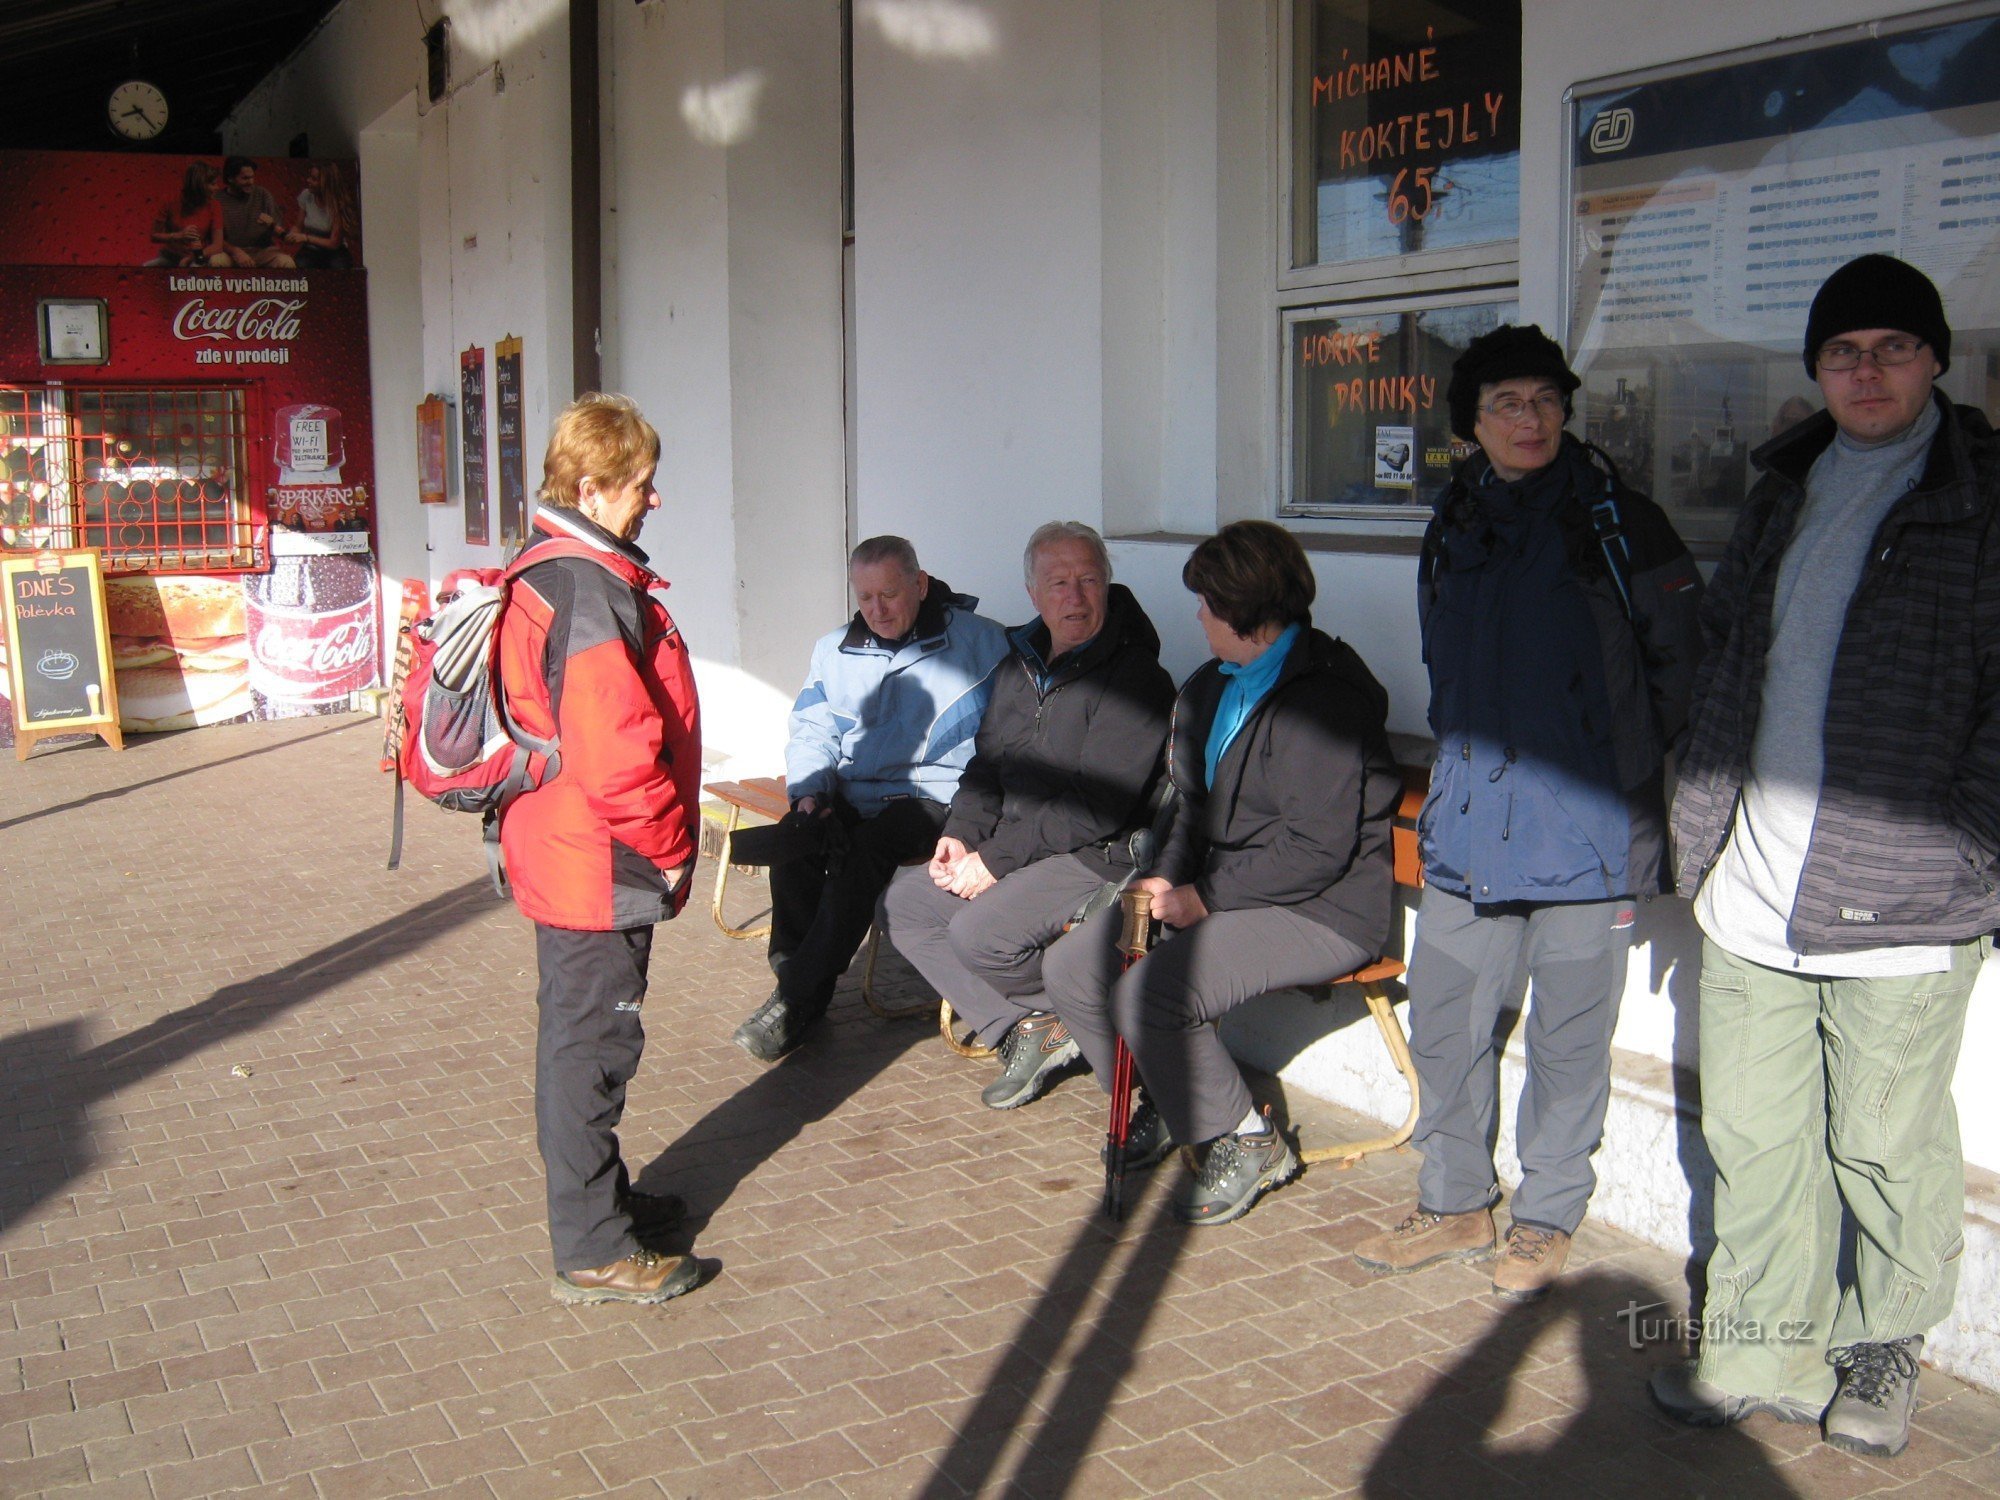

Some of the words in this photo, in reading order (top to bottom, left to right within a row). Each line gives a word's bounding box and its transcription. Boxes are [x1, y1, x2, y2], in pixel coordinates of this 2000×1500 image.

[1313, 25, 1440, 107] MÍCHANÉ
[1341, 92, 1503, 170] KOKTEJLY
[170, 276, 223, 292] Ledově
[225, 276, 309, 293] vychlazená
[173, 299, 308, 340] Coca-Cola
[196, 349, 221, 363] zde
[224, 351, 233, 363] v
[236, 348, 289, 365] prodeji
[1334, 373, 1436, 415] DRINKY
[295, 421, 320, 432] FREE
[292, 436, 318, 447] WI-FI
[17, 577, 75, 598] DNES
